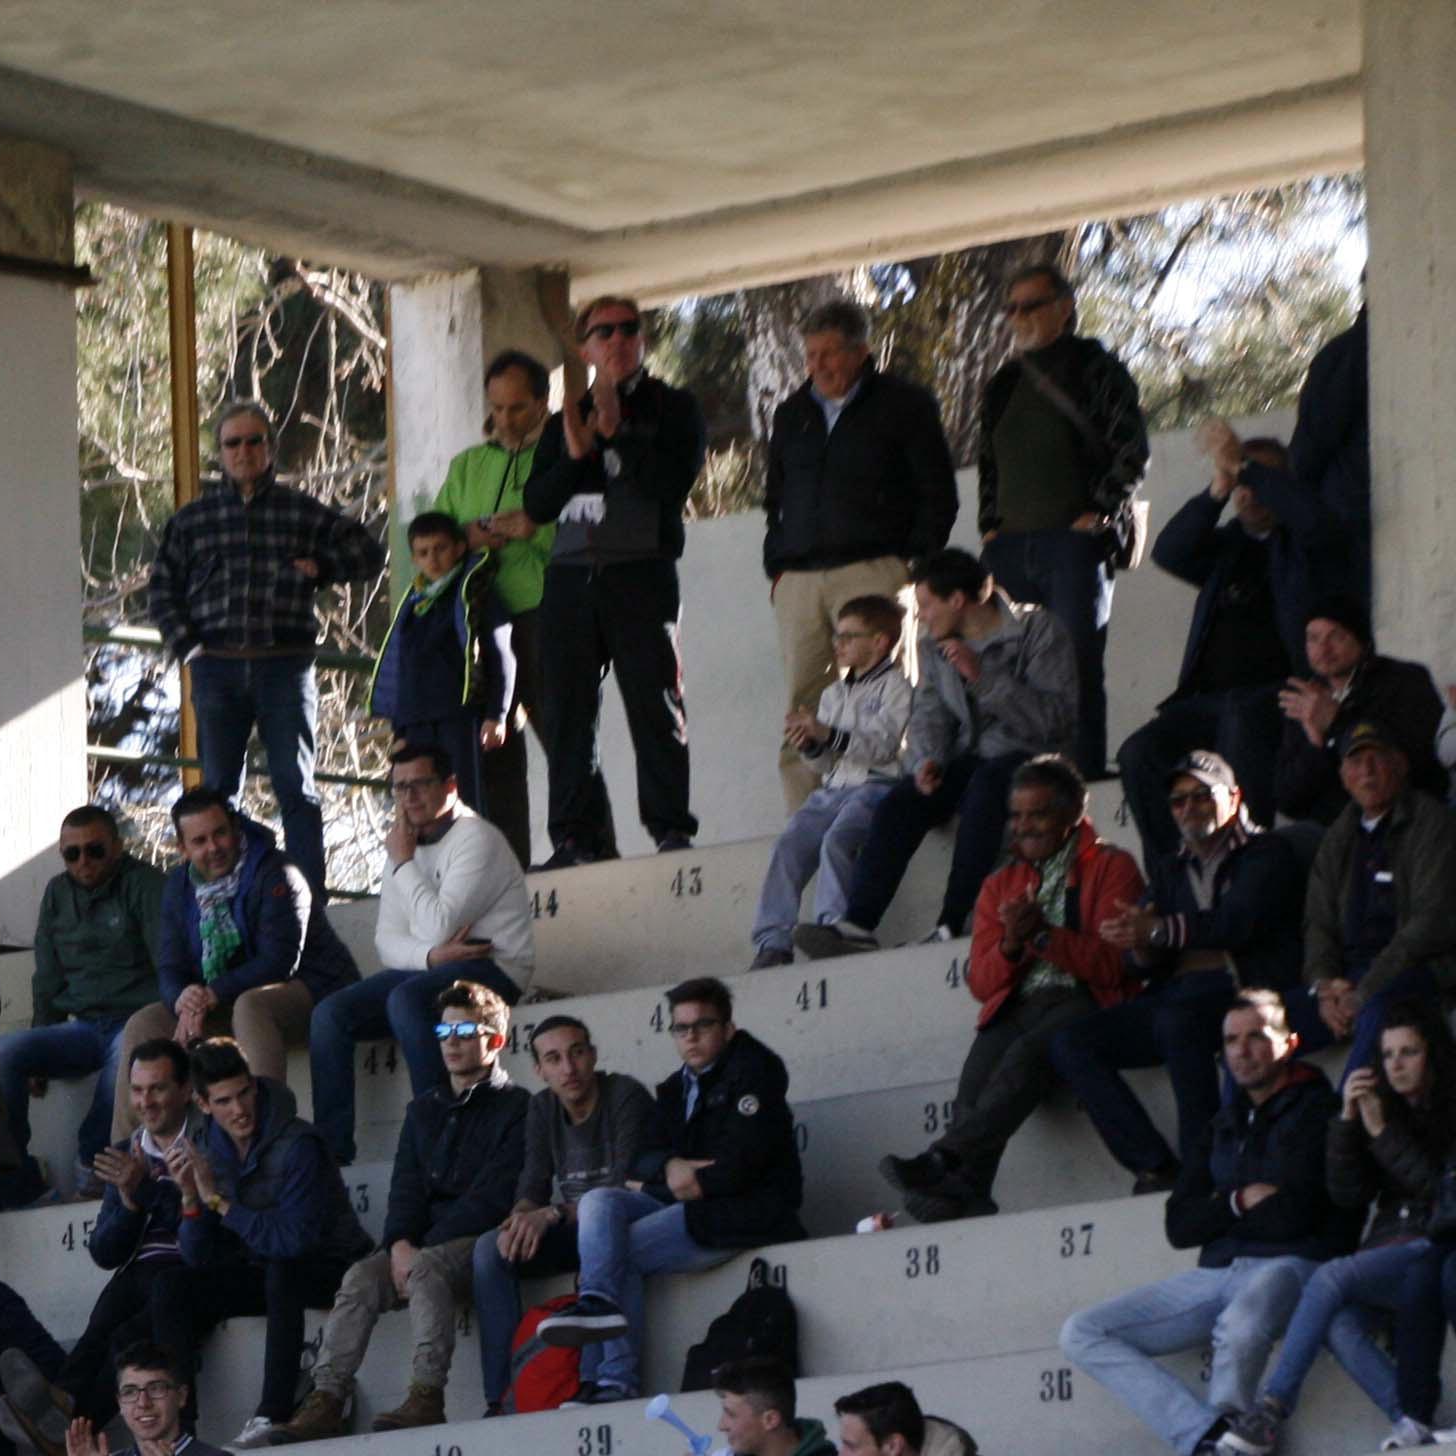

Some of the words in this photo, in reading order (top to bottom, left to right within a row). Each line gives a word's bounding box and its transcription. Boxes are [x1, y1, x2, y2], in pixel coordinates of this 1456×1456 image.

[671, 867, 703, 897] 43
[530, 888, 558, 919] 44
[796, 979, 827, 1010] 41
[363, 1043, 398, 1075] 44
[1060, 1222, 1094, 1258] 37
[905, 1244, 939, 1279] 38
[1199, 1349, 1213, 1382] 3
[1040, 1368, 1072, 1401] 36
